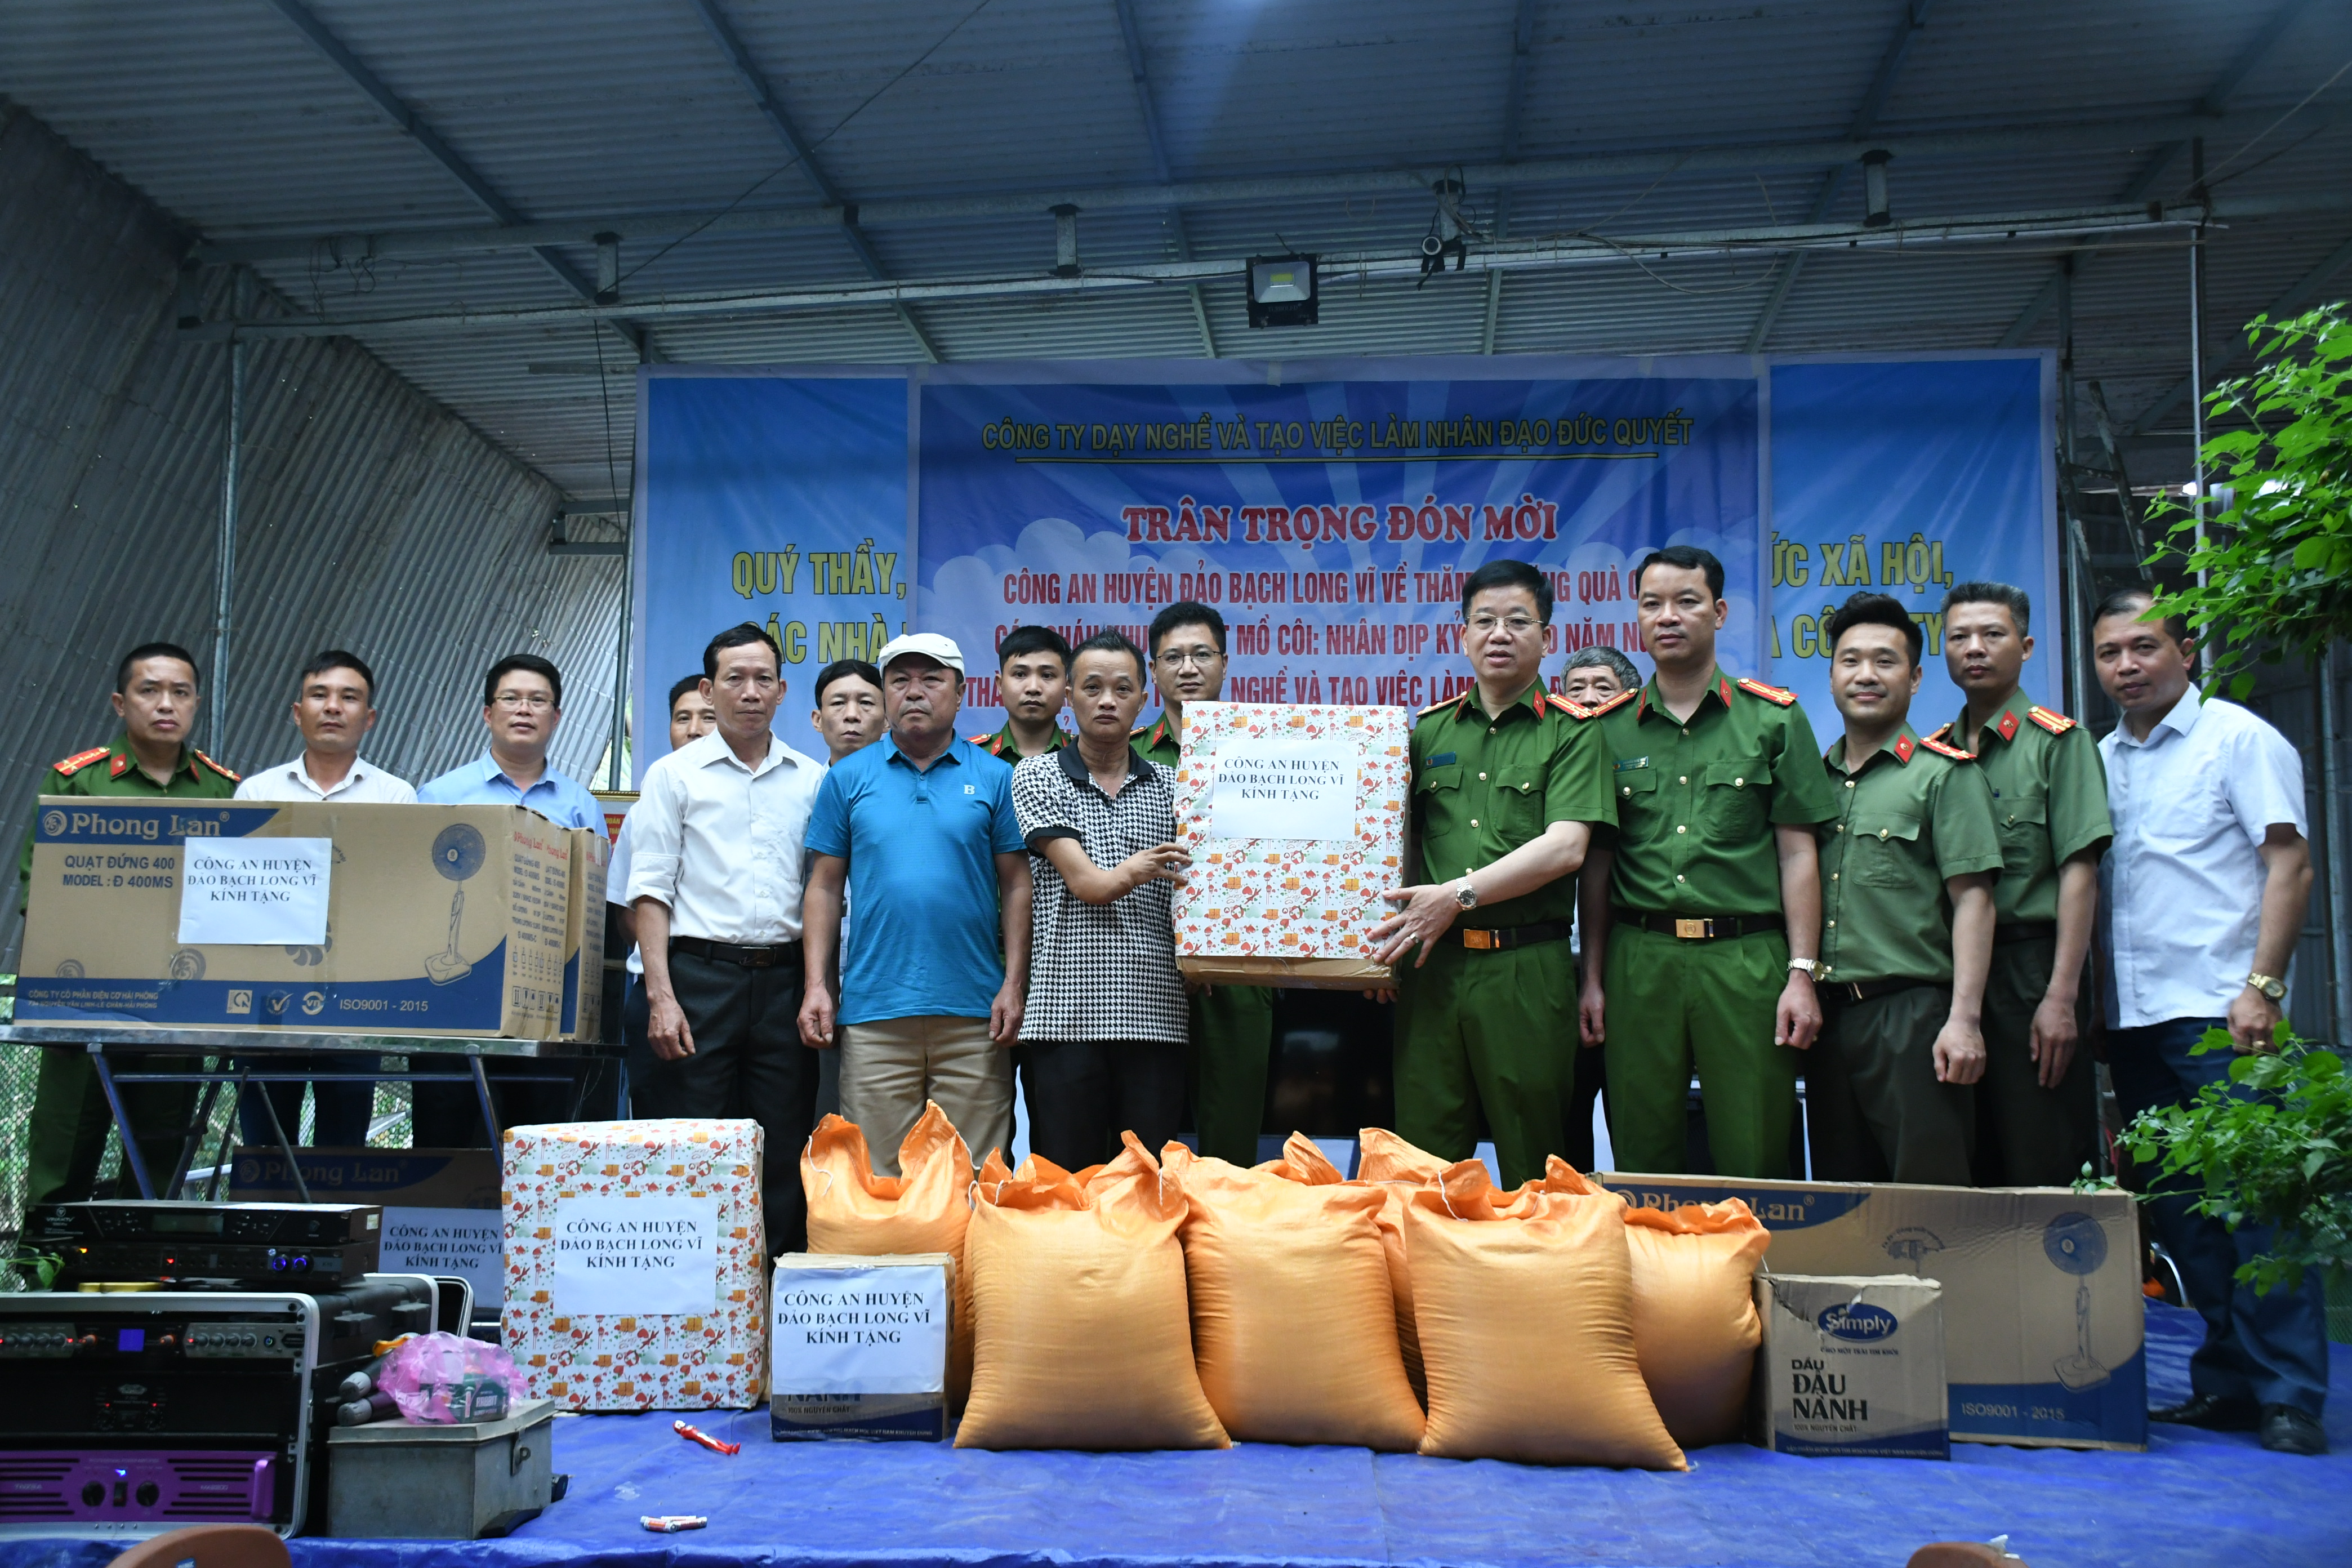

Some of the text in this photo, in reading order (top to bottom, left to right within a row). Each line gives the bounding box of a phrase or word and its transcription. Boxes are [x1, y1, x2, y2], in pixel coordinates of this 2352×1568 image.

[982, 408, 1694, 457] CÔNG TY DẠY NGHỀ VÀ TẠO VIỆC LÀM NHÂN ĐẠO ĐỨC QUYẾT
[1123, 495, 1558, 549] TRÂN TRỌNG ĐÓN MỜI
[732, 538, 906, 599] QUÝ THẦY,
[1819, 534, 1870, 586] XÃ
[1881, 533, 1953, 594] HỘI,
[1004, 568, 1059, 604] CÔNG
[1067, 573, 1096, 603] AN
[1104, 567, 1173, 610] HUYỆN
[1179, 559, 1221, 603] ĐẢO
[1229, 572, 1285, 610] BẠCH
[1293, 572, 1348, 603] LONG
[1355, 566, 1377, 603] VĨ
[1382, 562, 1408, 603] VỀ
[1578, 565, 1621, 605] QUÀ
[750, 612, 889, 664] ÁC NHÀ
[1237, 614, 1270, 655] MỒ
[1277, 618, 1319, 655] CÔI:
[1327, 618, 1386, 655] NHÂN
[1393, 624, 1428, 661] DỊP
[1566, 617, 1615, 654] NĂM
[1231, 665, 1288, 704] NGHỀ
[1294, 670, 1322, 705] VÀ
[1224, 756, 1340, 773] CÔNG AN HUYỆN
[1218, 770, 1344, 786] ĐẢO BẠCH LONG VĨ
[964, 785, 975, 795] B
[1241, 787, 1319, 803] KÍNH TẶNG
[71, 813, 160, 840] Phong
[65, 853, 175, 871] QUẠT ĐỨNG 400
[194, 857, 312, 873] CÔNG AN HUYỆN
[63, 874, 104, 887] MODEL
[113, 875, 123, 887] Đ
[128, 875, 173, 888] 400MS
[188, 871, 317, 888] ĐẢO BẠCH LONG VĨ
[210, 888, 291, 904] KÍNH TẶNG
[340, 999, 389, 1010] ISO9001
[400, 1000, 428, 1012] 2015
[390, 1223, 498, 1242] CÔNG AN HUYỆN
[567, 1220, 697, 1235] CÔNG AN HUYỆN
[384, 1239, 503, 1254] ĐẢO BẠCH LONG VĨ
[560, 1236, 702, 1254] ĐẢO BẠCH LONG VĨ
[406, 1253, 479, 1271] KÍNH TẶNG
[587, 1253, 675, 1271] KÍNH TẶNG
[784, 1290, 924, 1308] CÔNG AN HUYỆN
[778, 1309, 930, 1328] ĐẢO BẠCH LONG VĨ
[1826, 1313, 1892, 1335] Simply
[807, 1328, 901, 1347] KÍNH TẶNG
[1792, 1393, 1868, 1420] NÀNH
[1962, 1402, 2018, 1417] ISO9001
[2032, 1406, 2065, 1421] 2015
